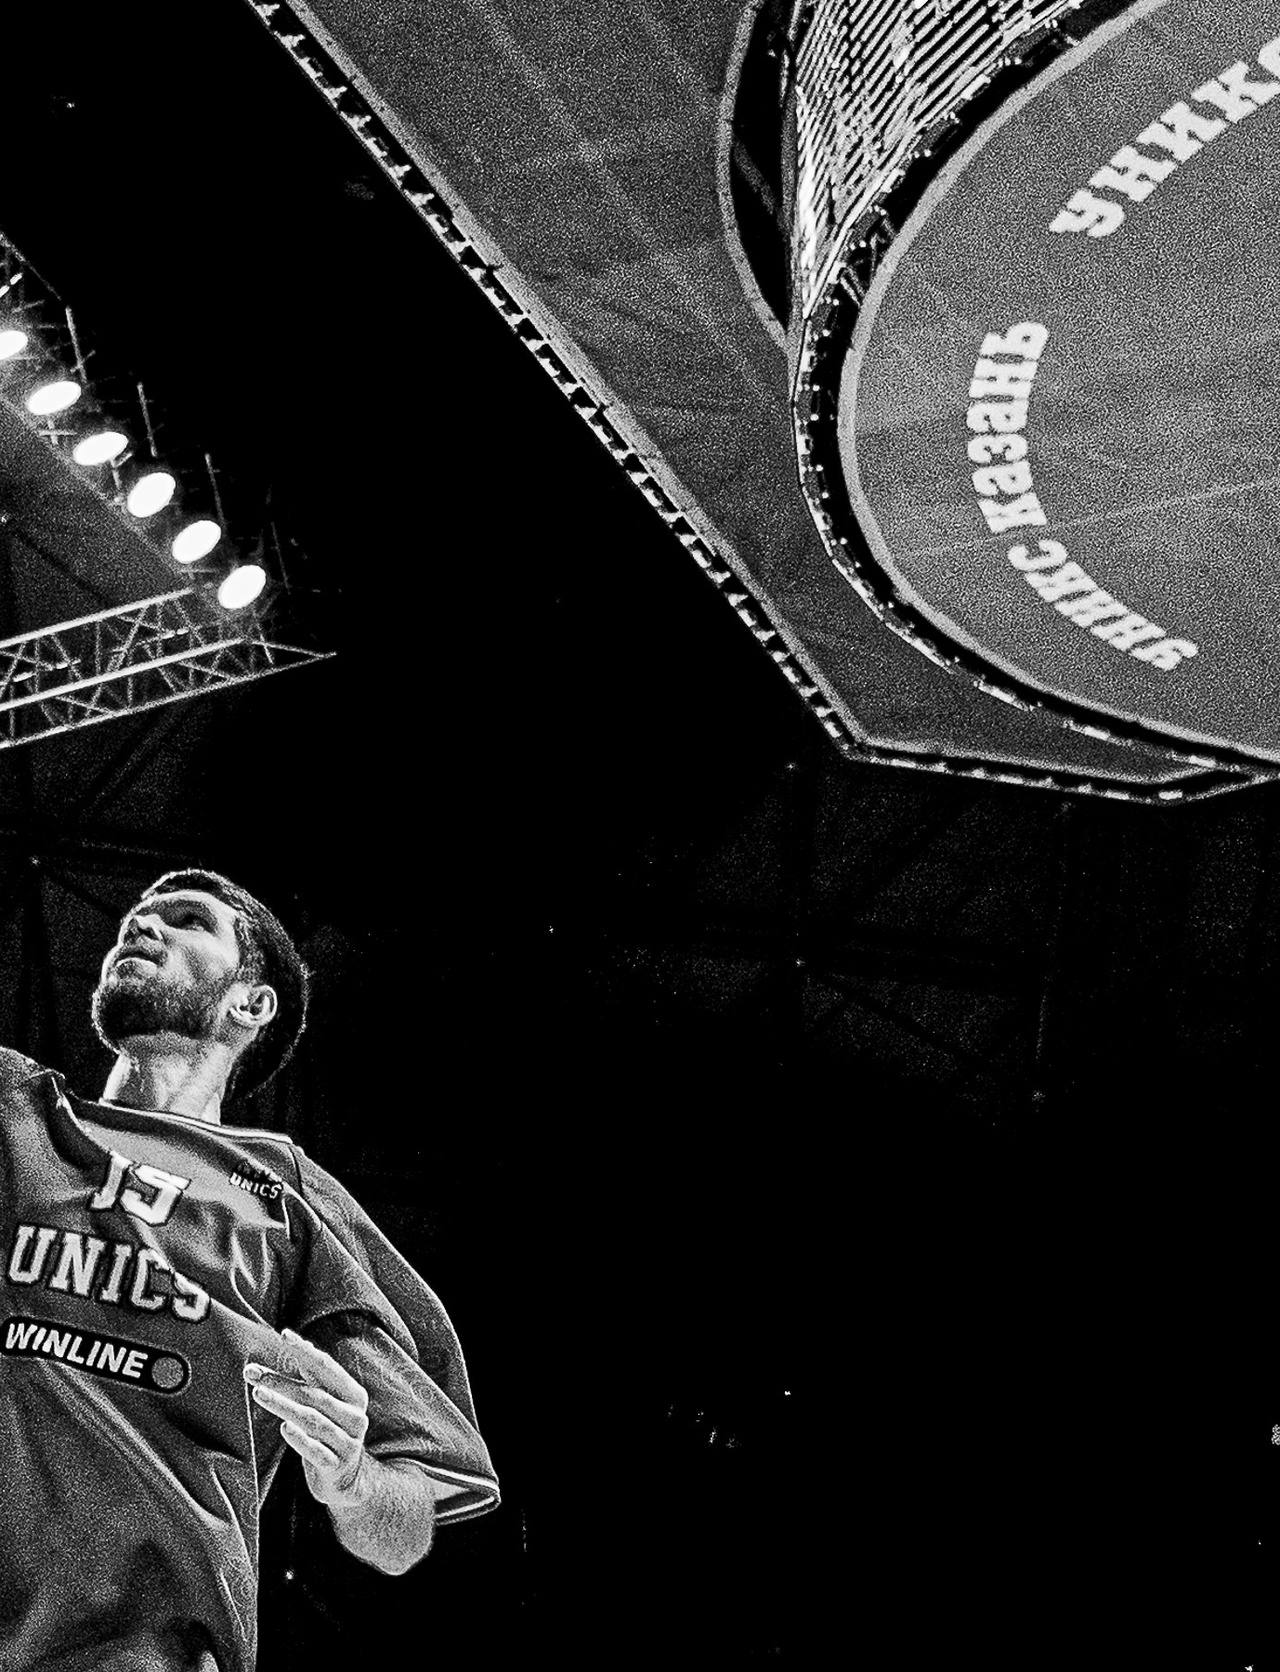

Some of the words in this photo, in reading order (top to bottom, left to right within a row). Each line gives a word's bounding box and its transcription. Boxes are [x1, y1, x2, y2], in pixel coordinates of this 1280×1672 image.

[1006, 537, 1198, 672] УНИКС
[230, 1172, 282, 1199] UNICS
[8, 1225, 211, 1323] UNICS
[5, 1322, 149, 1379] WINLINE
